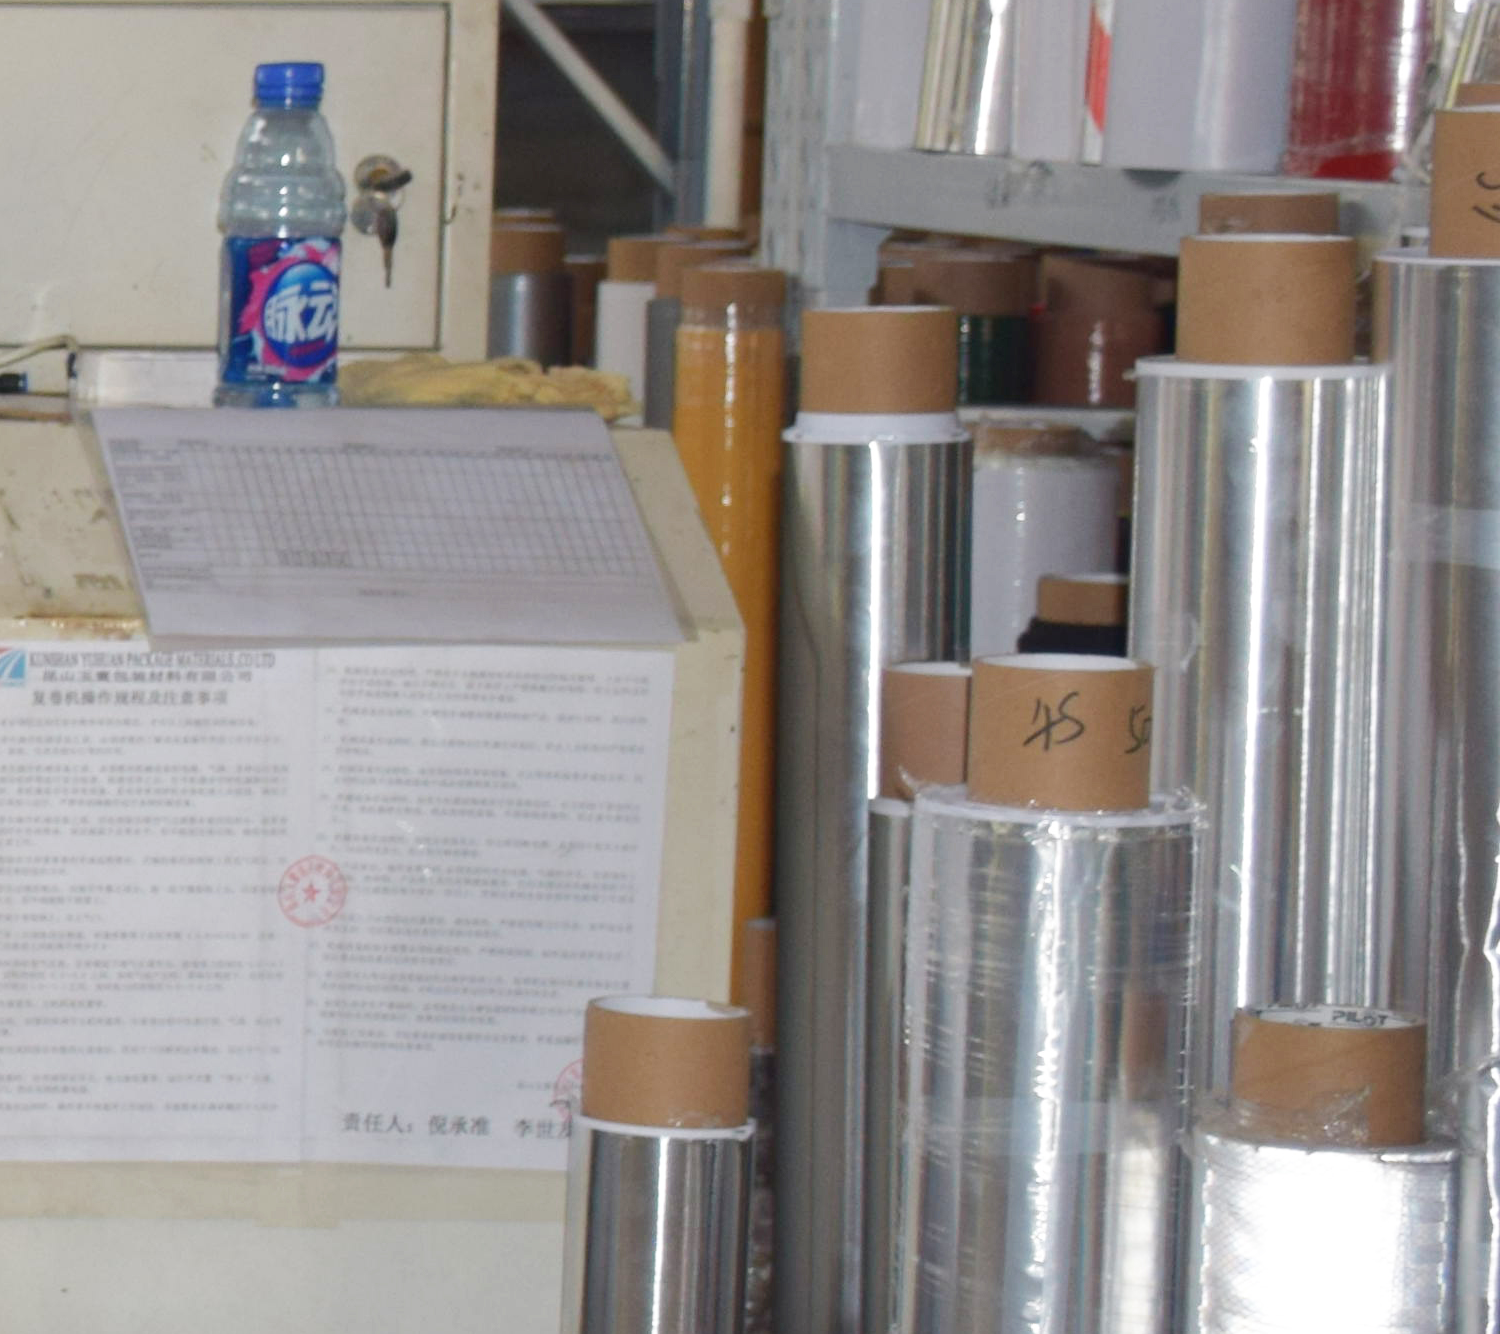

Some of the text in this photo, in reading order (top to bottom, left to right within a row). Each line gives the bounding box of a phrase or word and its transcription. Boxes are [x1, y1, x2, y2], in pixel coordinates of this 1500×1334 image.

[32, 689, 229, 706] 复卷机操作规程及注意事项
